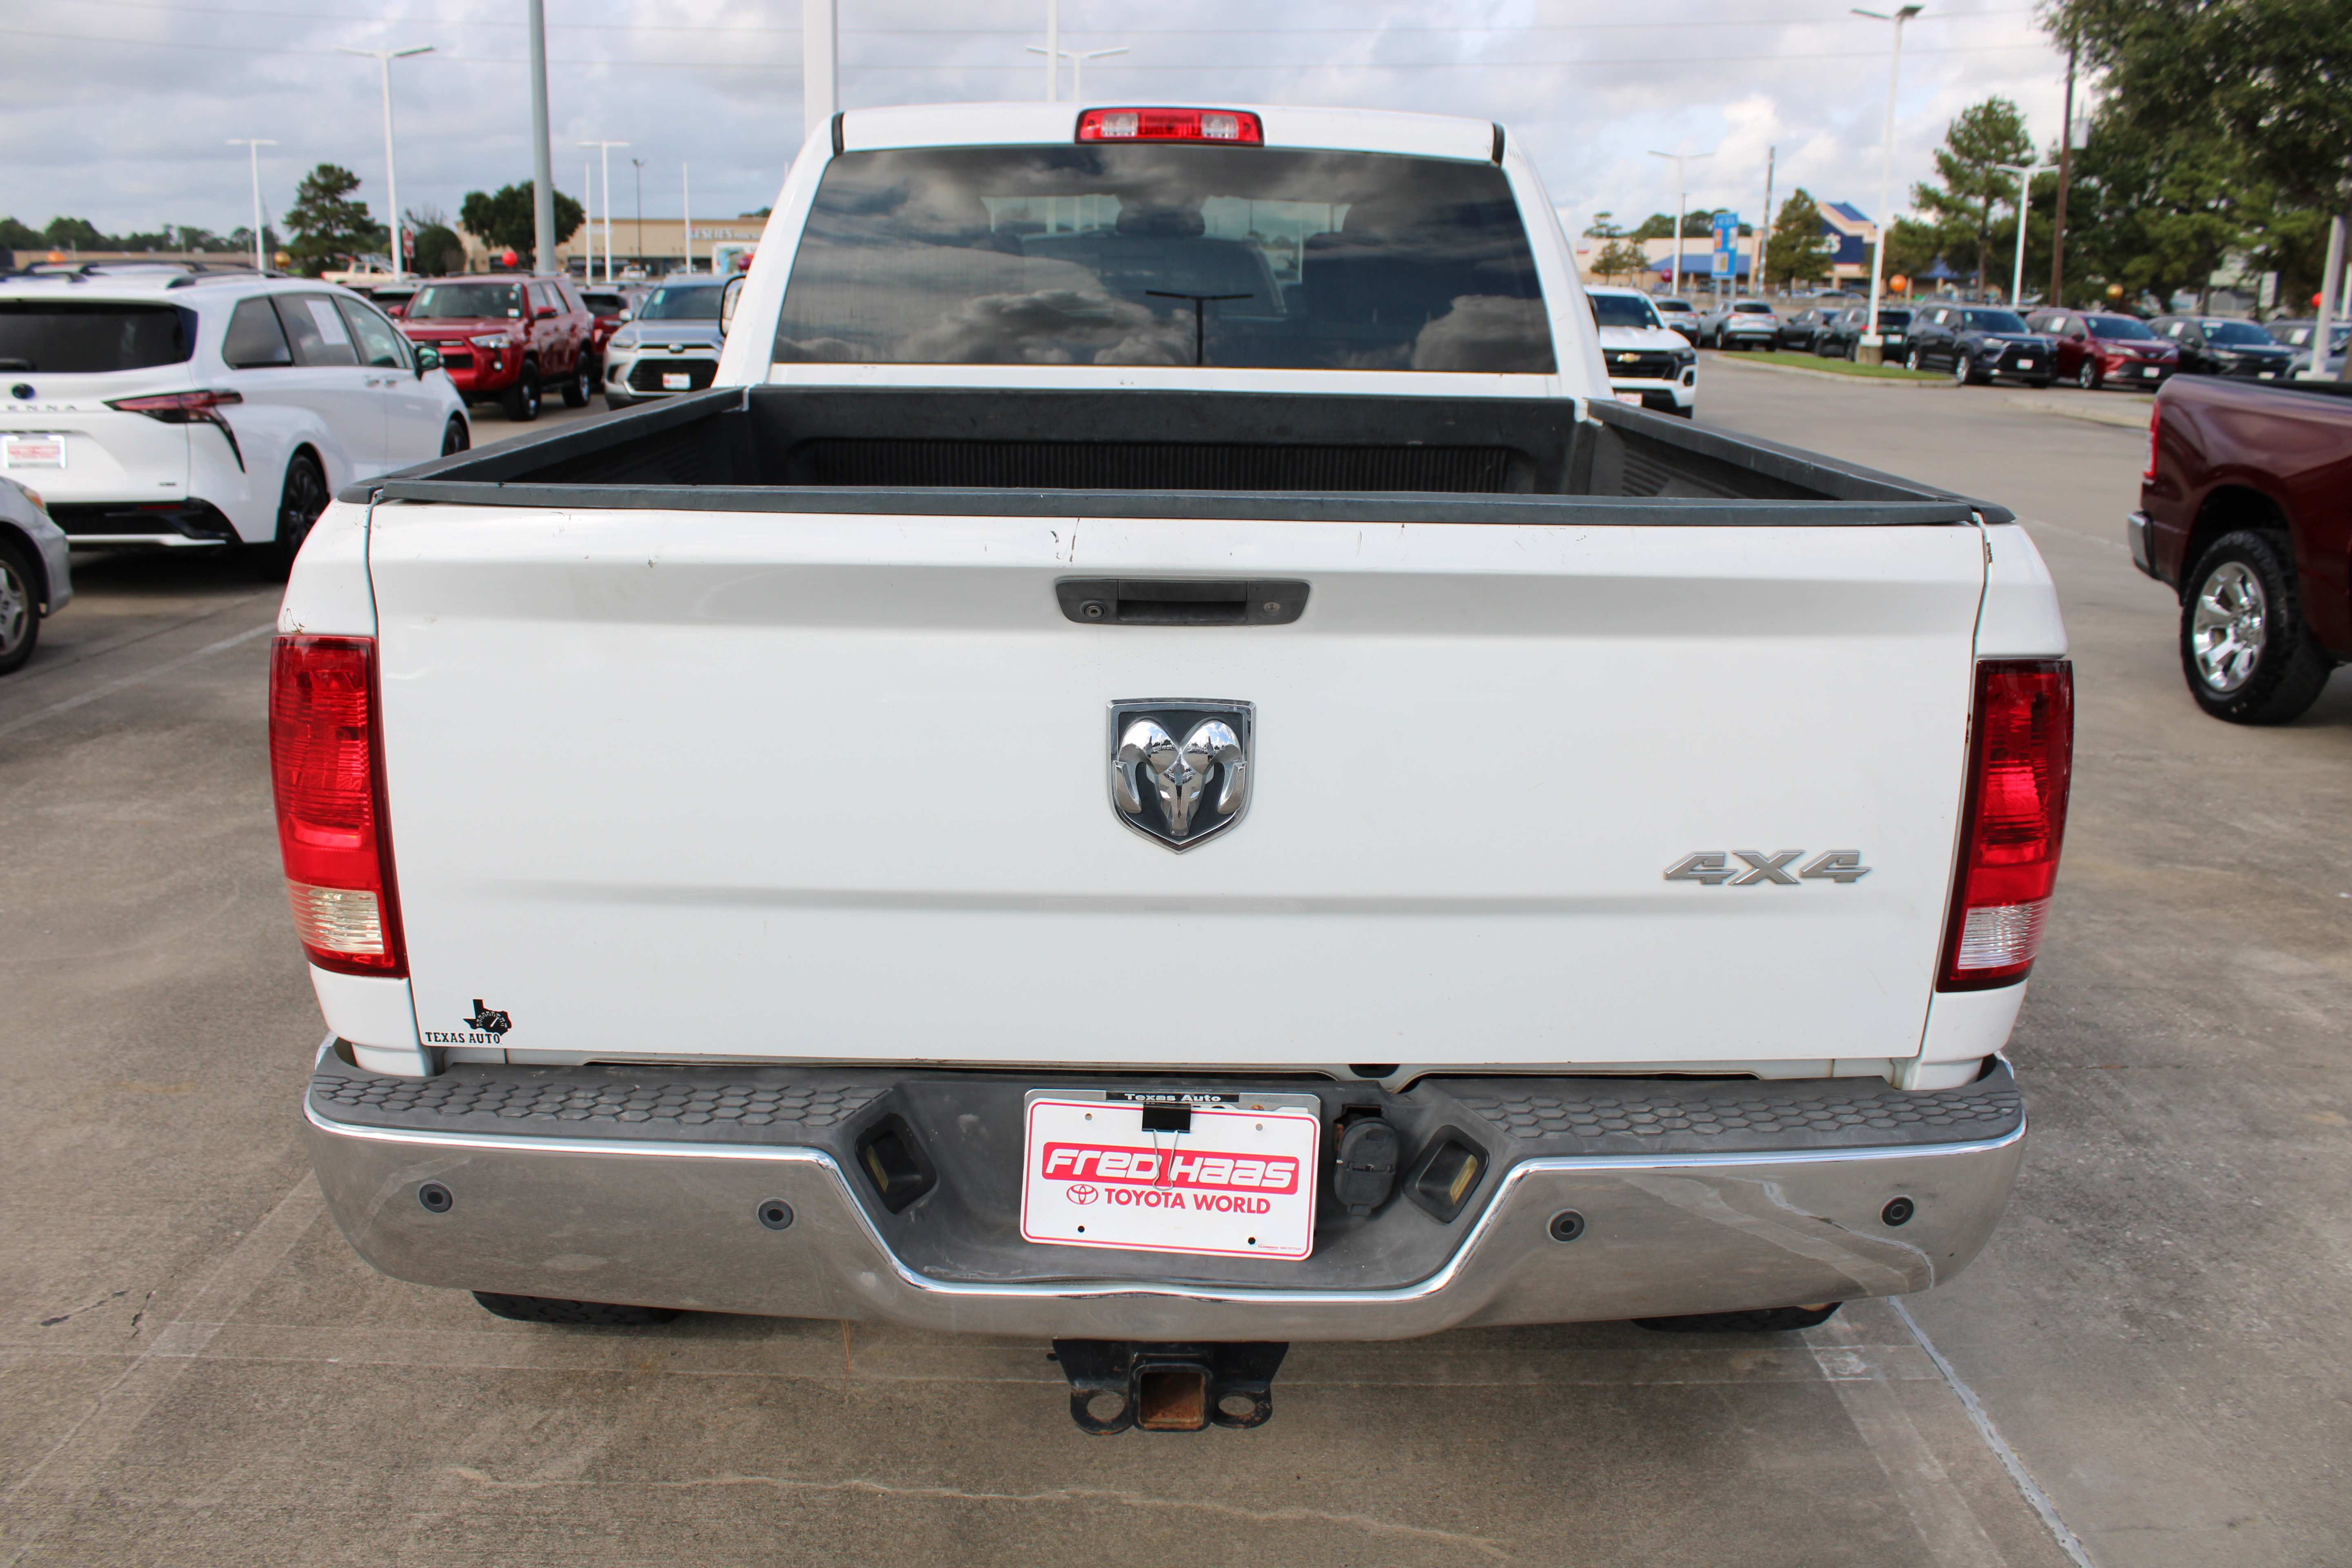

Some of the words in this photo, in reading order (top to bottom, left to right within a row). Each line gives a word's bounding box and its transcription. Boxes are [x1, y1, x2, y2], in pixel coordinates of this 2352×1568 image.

[425, 1032, 466, 1043] TEXAS
[469, 1033, 501, 1044] AUTO
[1124, 1093, 1176, 1101] Texas
[1104, 1188, 1186, 1209] TOYOTA
[1193, 1194, 1271, 1214] WORLD
